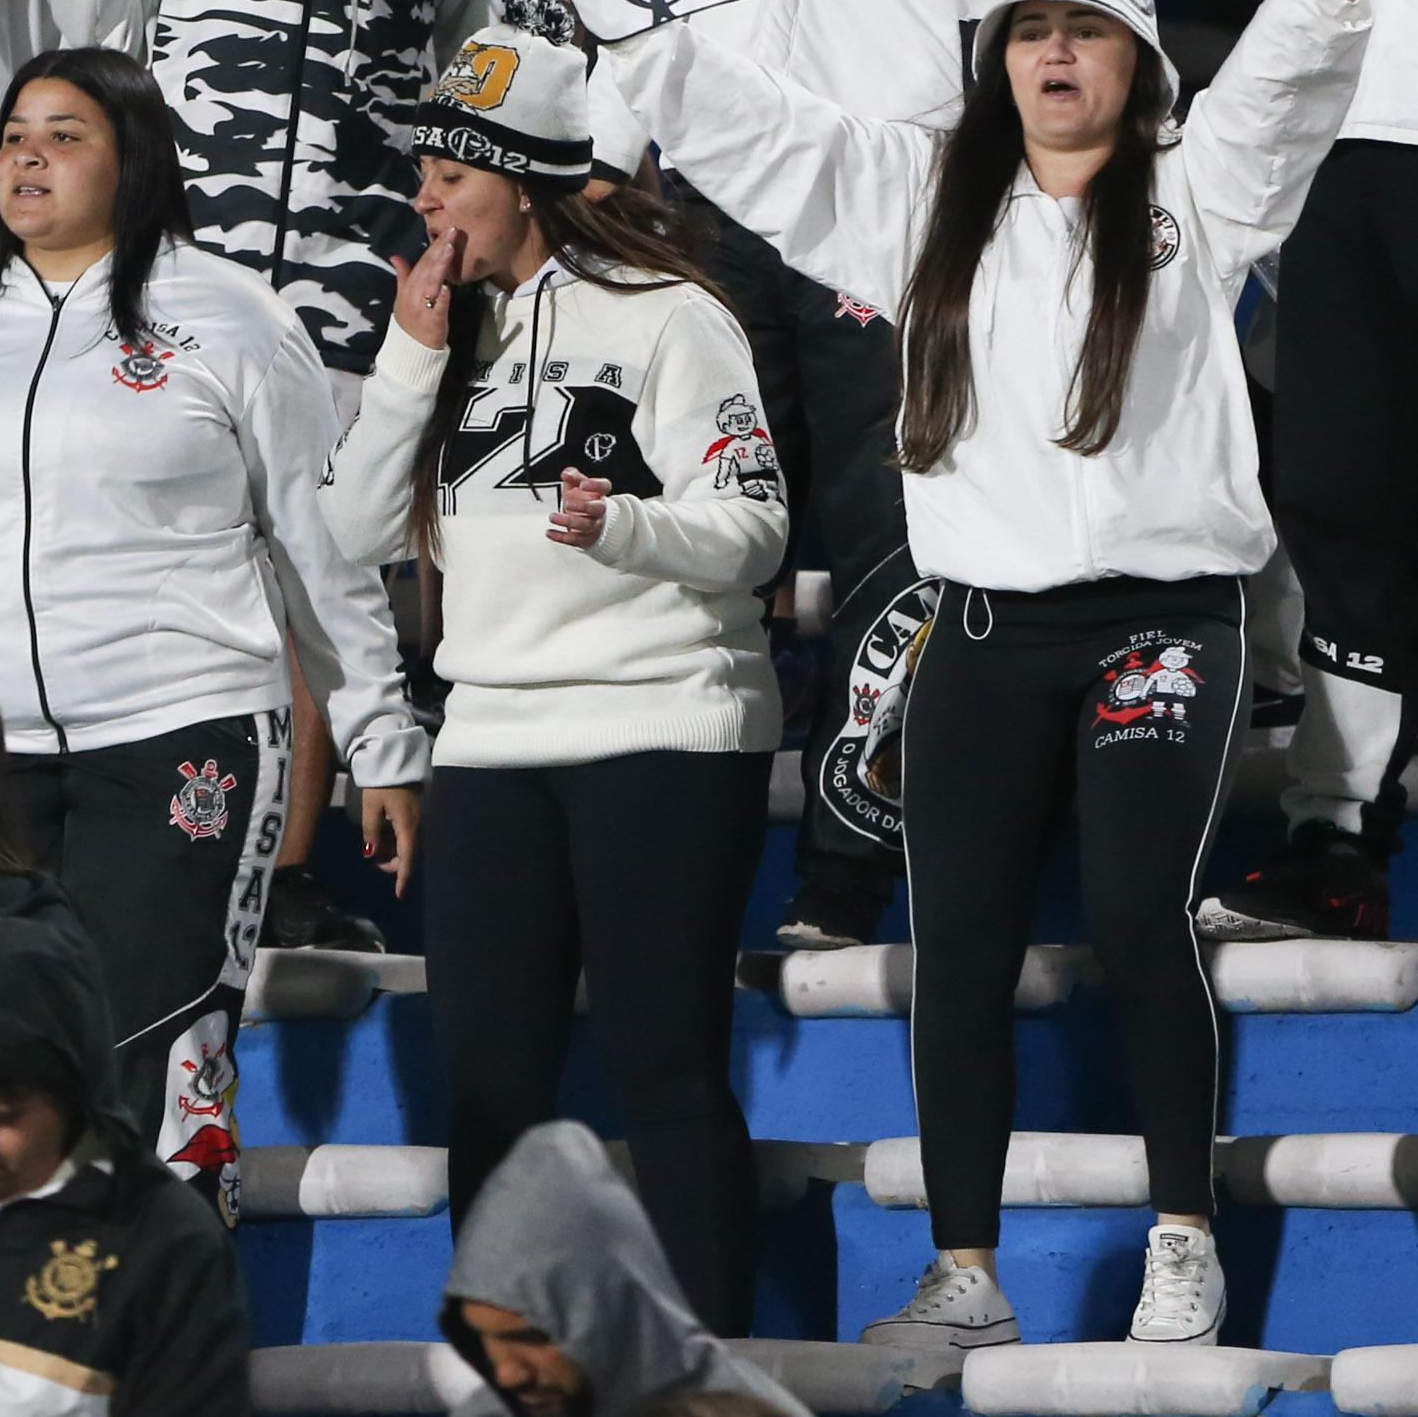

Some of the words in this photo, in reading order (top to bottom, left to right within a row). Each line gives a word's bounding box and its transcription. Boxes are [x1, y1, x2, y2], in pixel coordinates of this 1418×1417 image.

[412, 126, 445, 149] SA
[490, 146, 529, 174] 12
[104, 321, 181, 344] CISA
[179, 336, 201, 353] 12
[439, 386, 576, 515] 2
[1099, 639, 1152, 669] TORCIDA
[1156, 637, 1202, 652] JOVEM
[1129, 630, 1166, 644] FIEL
[1346, 651, 1384, 674] 12
[1095, 727, 1158, 749] CAMISA
[1167, 729, 1185, 743] 12
[833, 757, 880, 823] JOGADOR
[239, 707, 292, 914] MISA
